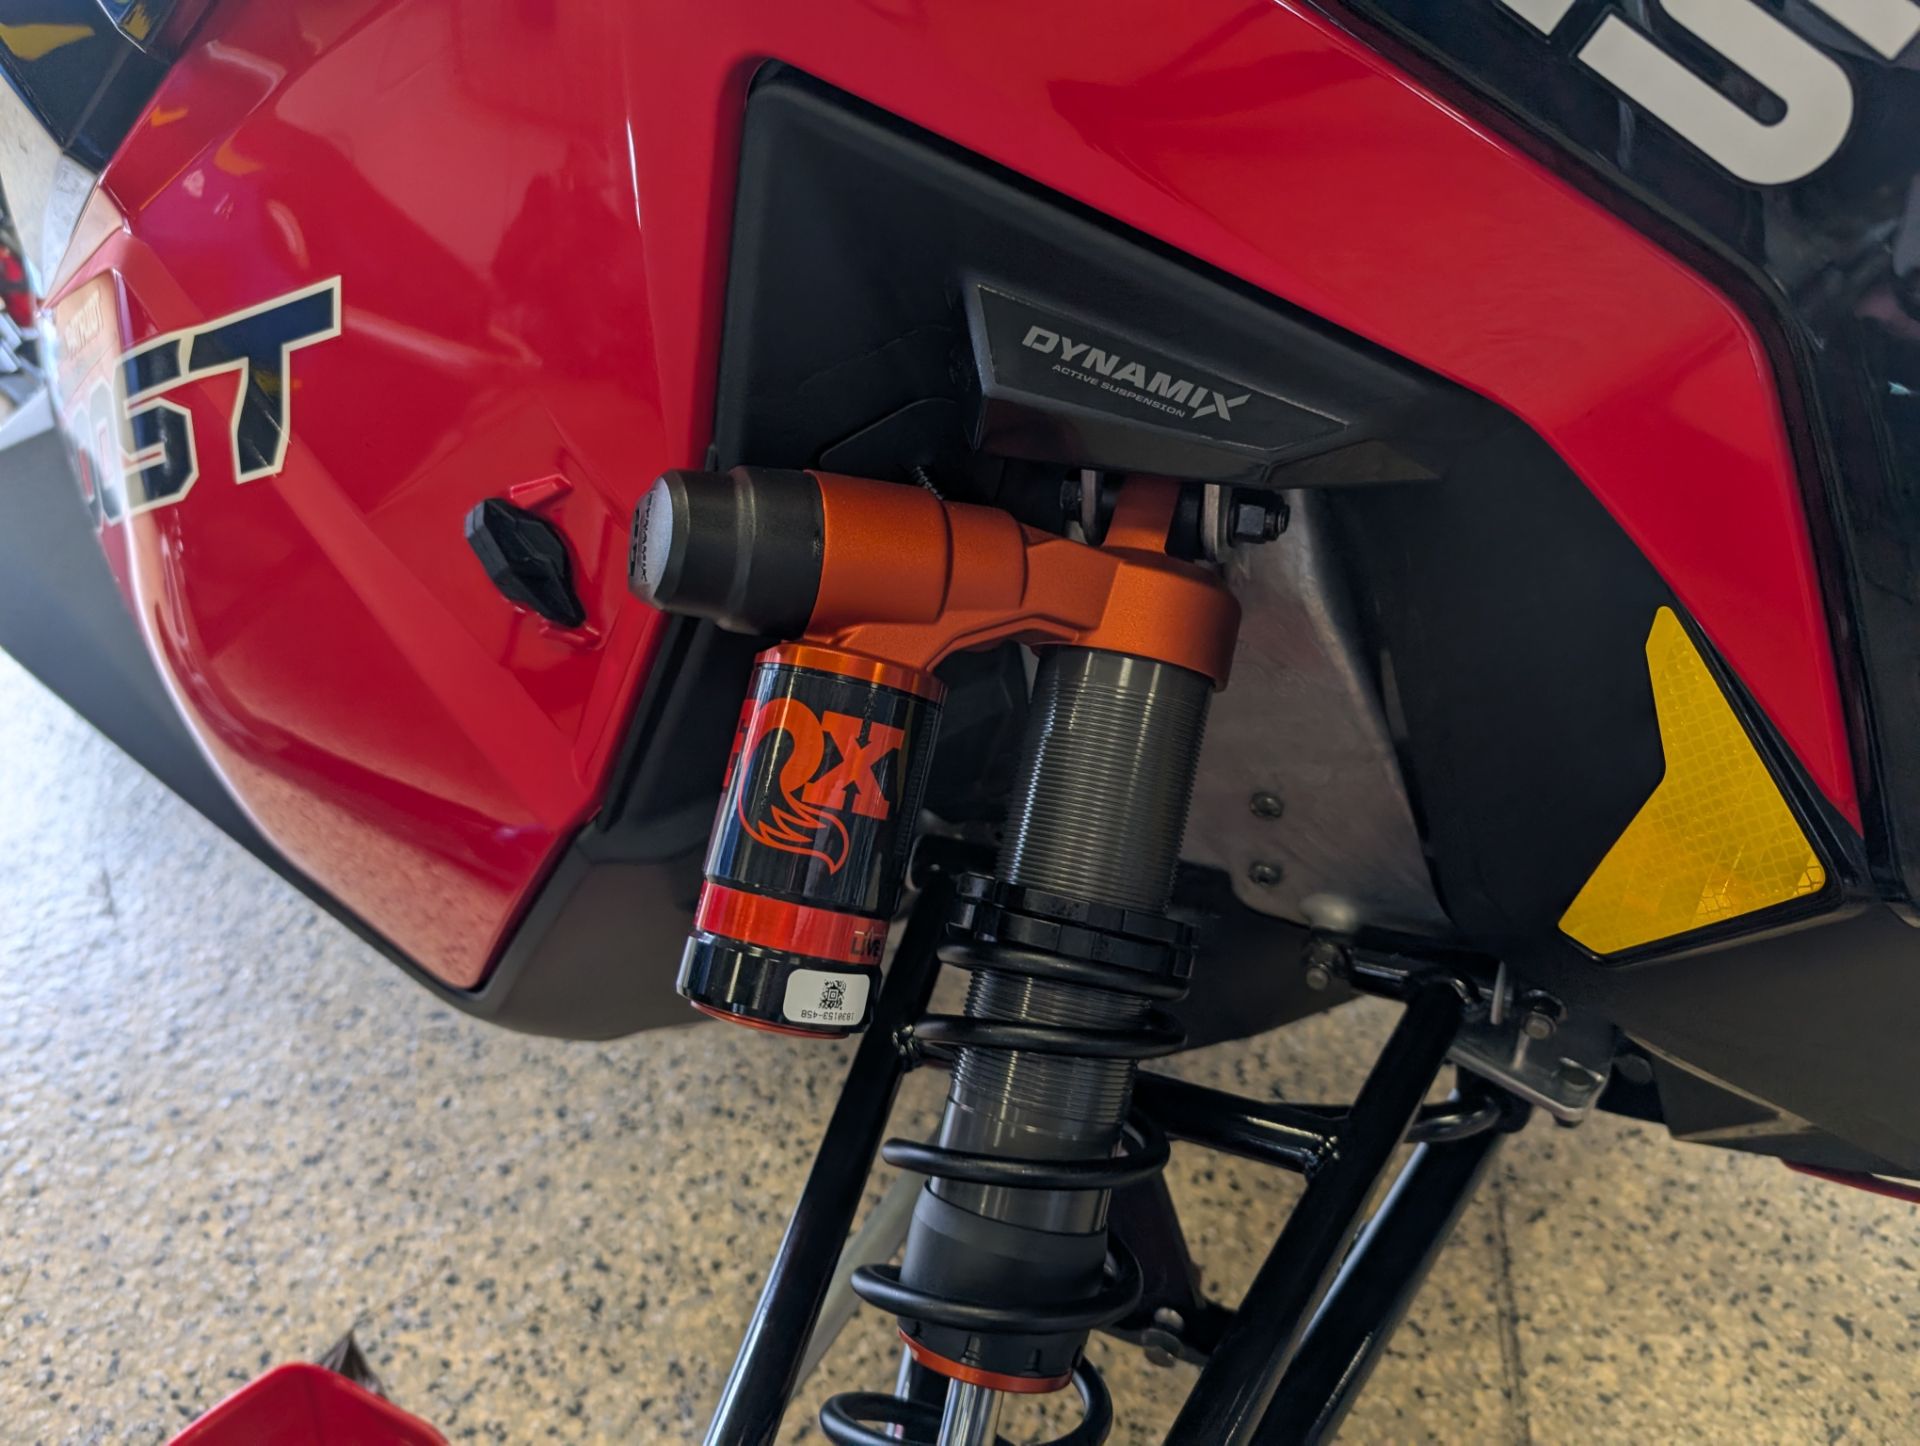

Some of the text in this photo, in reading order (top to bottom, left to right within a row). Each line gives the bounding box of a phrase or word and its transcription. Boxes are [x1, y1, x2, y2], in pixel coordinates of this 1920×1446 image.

[1021, 325, 1251, 422] DYNAMIX
[1052, 364, 1186, 418] ACTIVE SUSPENSION
